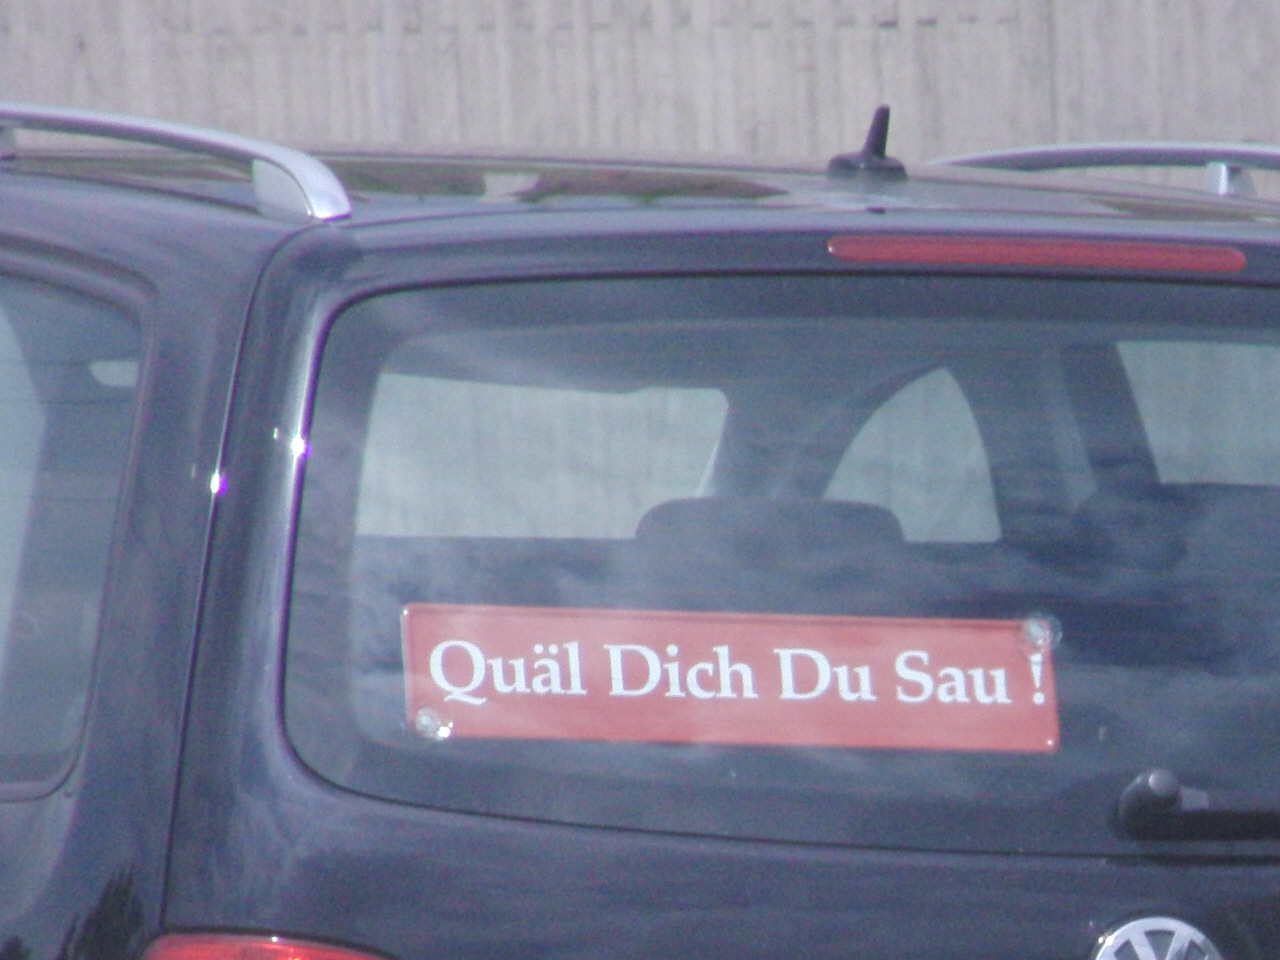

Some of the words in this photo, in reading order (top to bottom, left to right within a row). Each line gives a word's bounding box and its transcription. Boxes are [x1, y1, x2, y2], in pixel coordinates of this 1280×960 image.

[428, 638, 588, 706] Quäl
[603, 643, 759, 699] Dich
[774, 647, 878, 702] Du
[895, 649, 1012, 704] Sau
[1028, 653, 1046, 706] !
